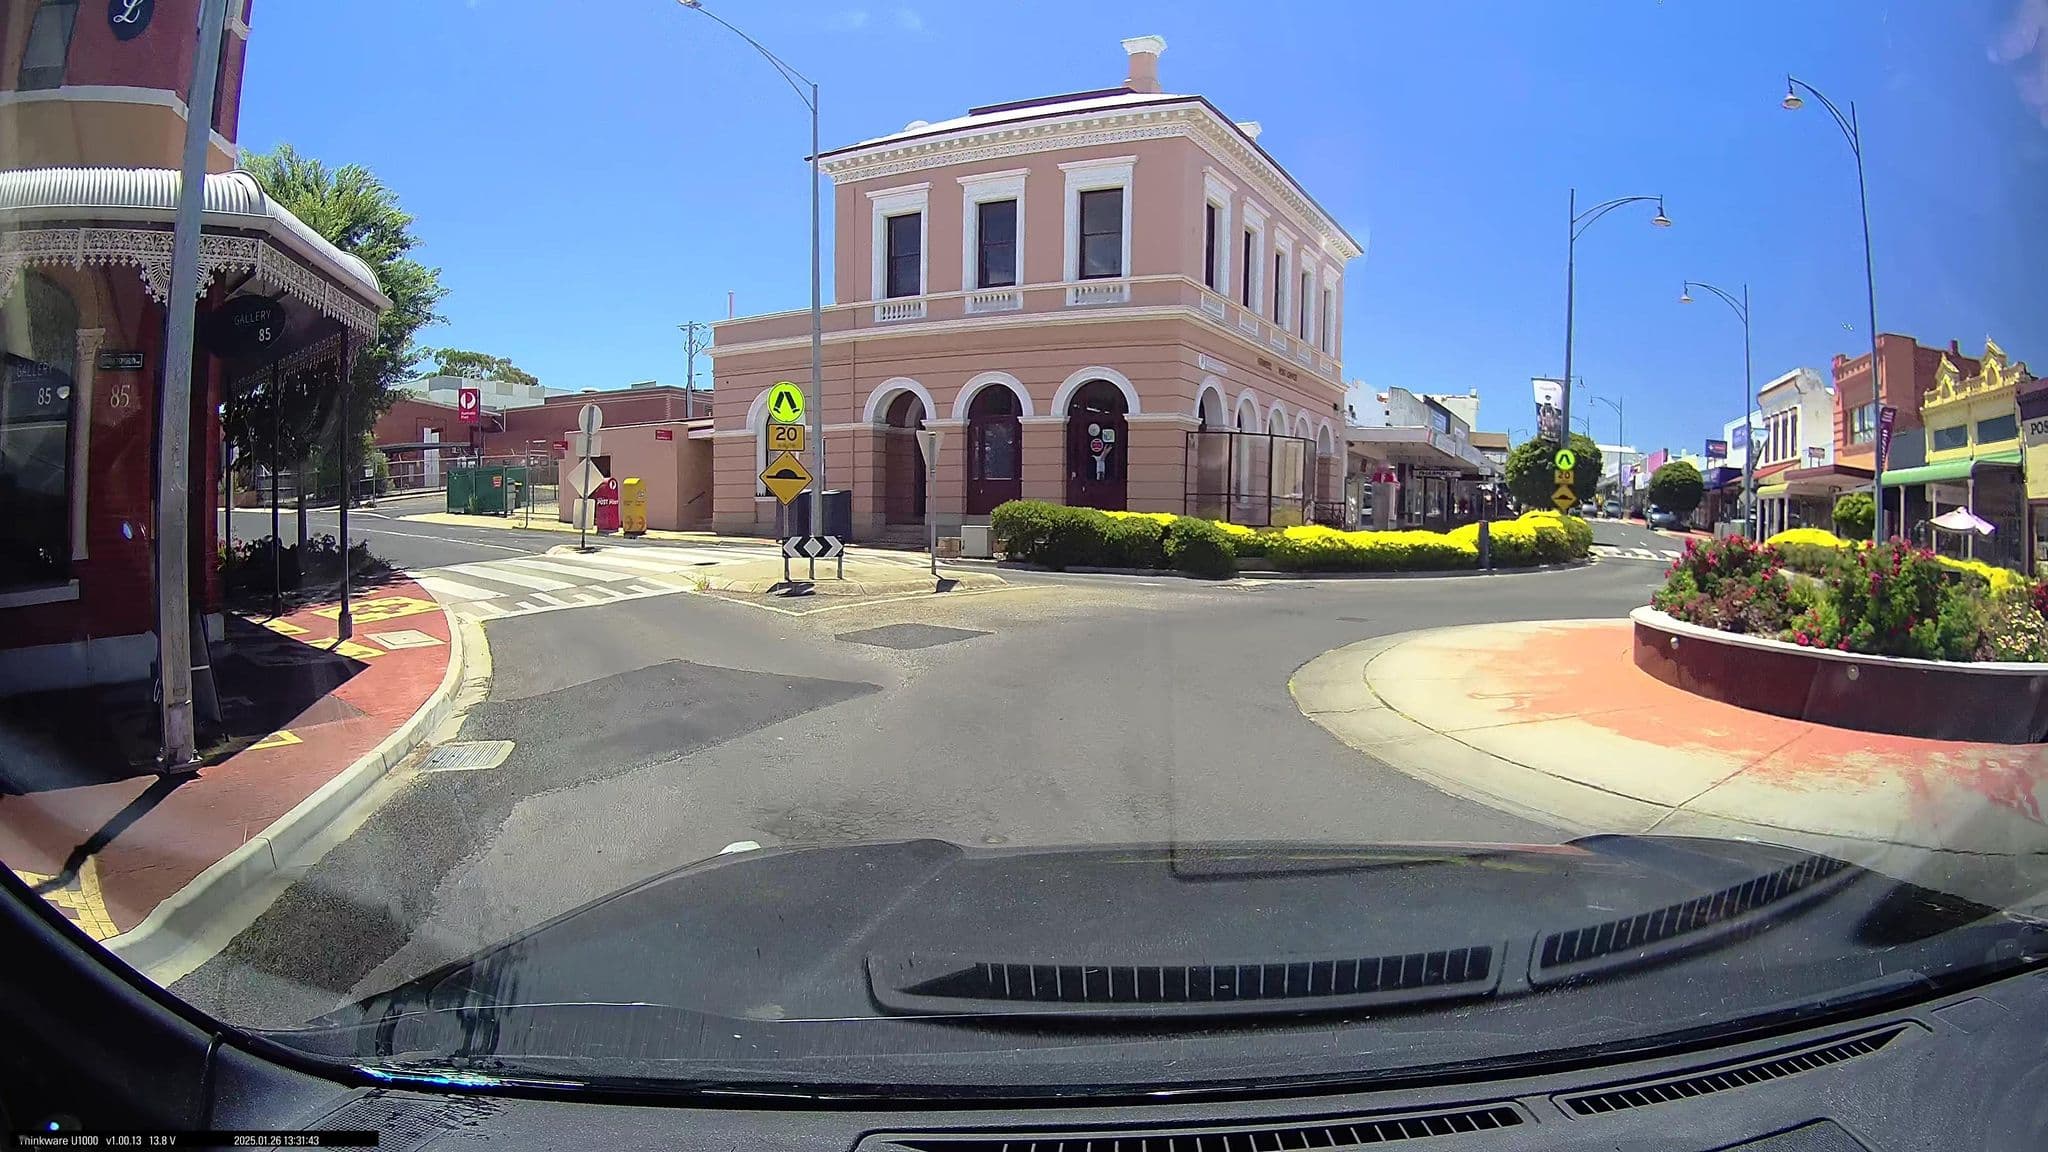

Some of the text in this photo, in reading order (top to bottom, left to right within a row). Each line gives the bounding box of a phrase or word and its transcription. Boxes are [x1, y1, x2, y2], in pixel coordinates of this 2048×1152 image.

[234, 310, 271, 326] GALLERY
[258, 327, 271, 342] 85
[38, 387, 52, 405] 85
[110, 384, 130, 408] 85
[775, 426, 798, 441] 20
